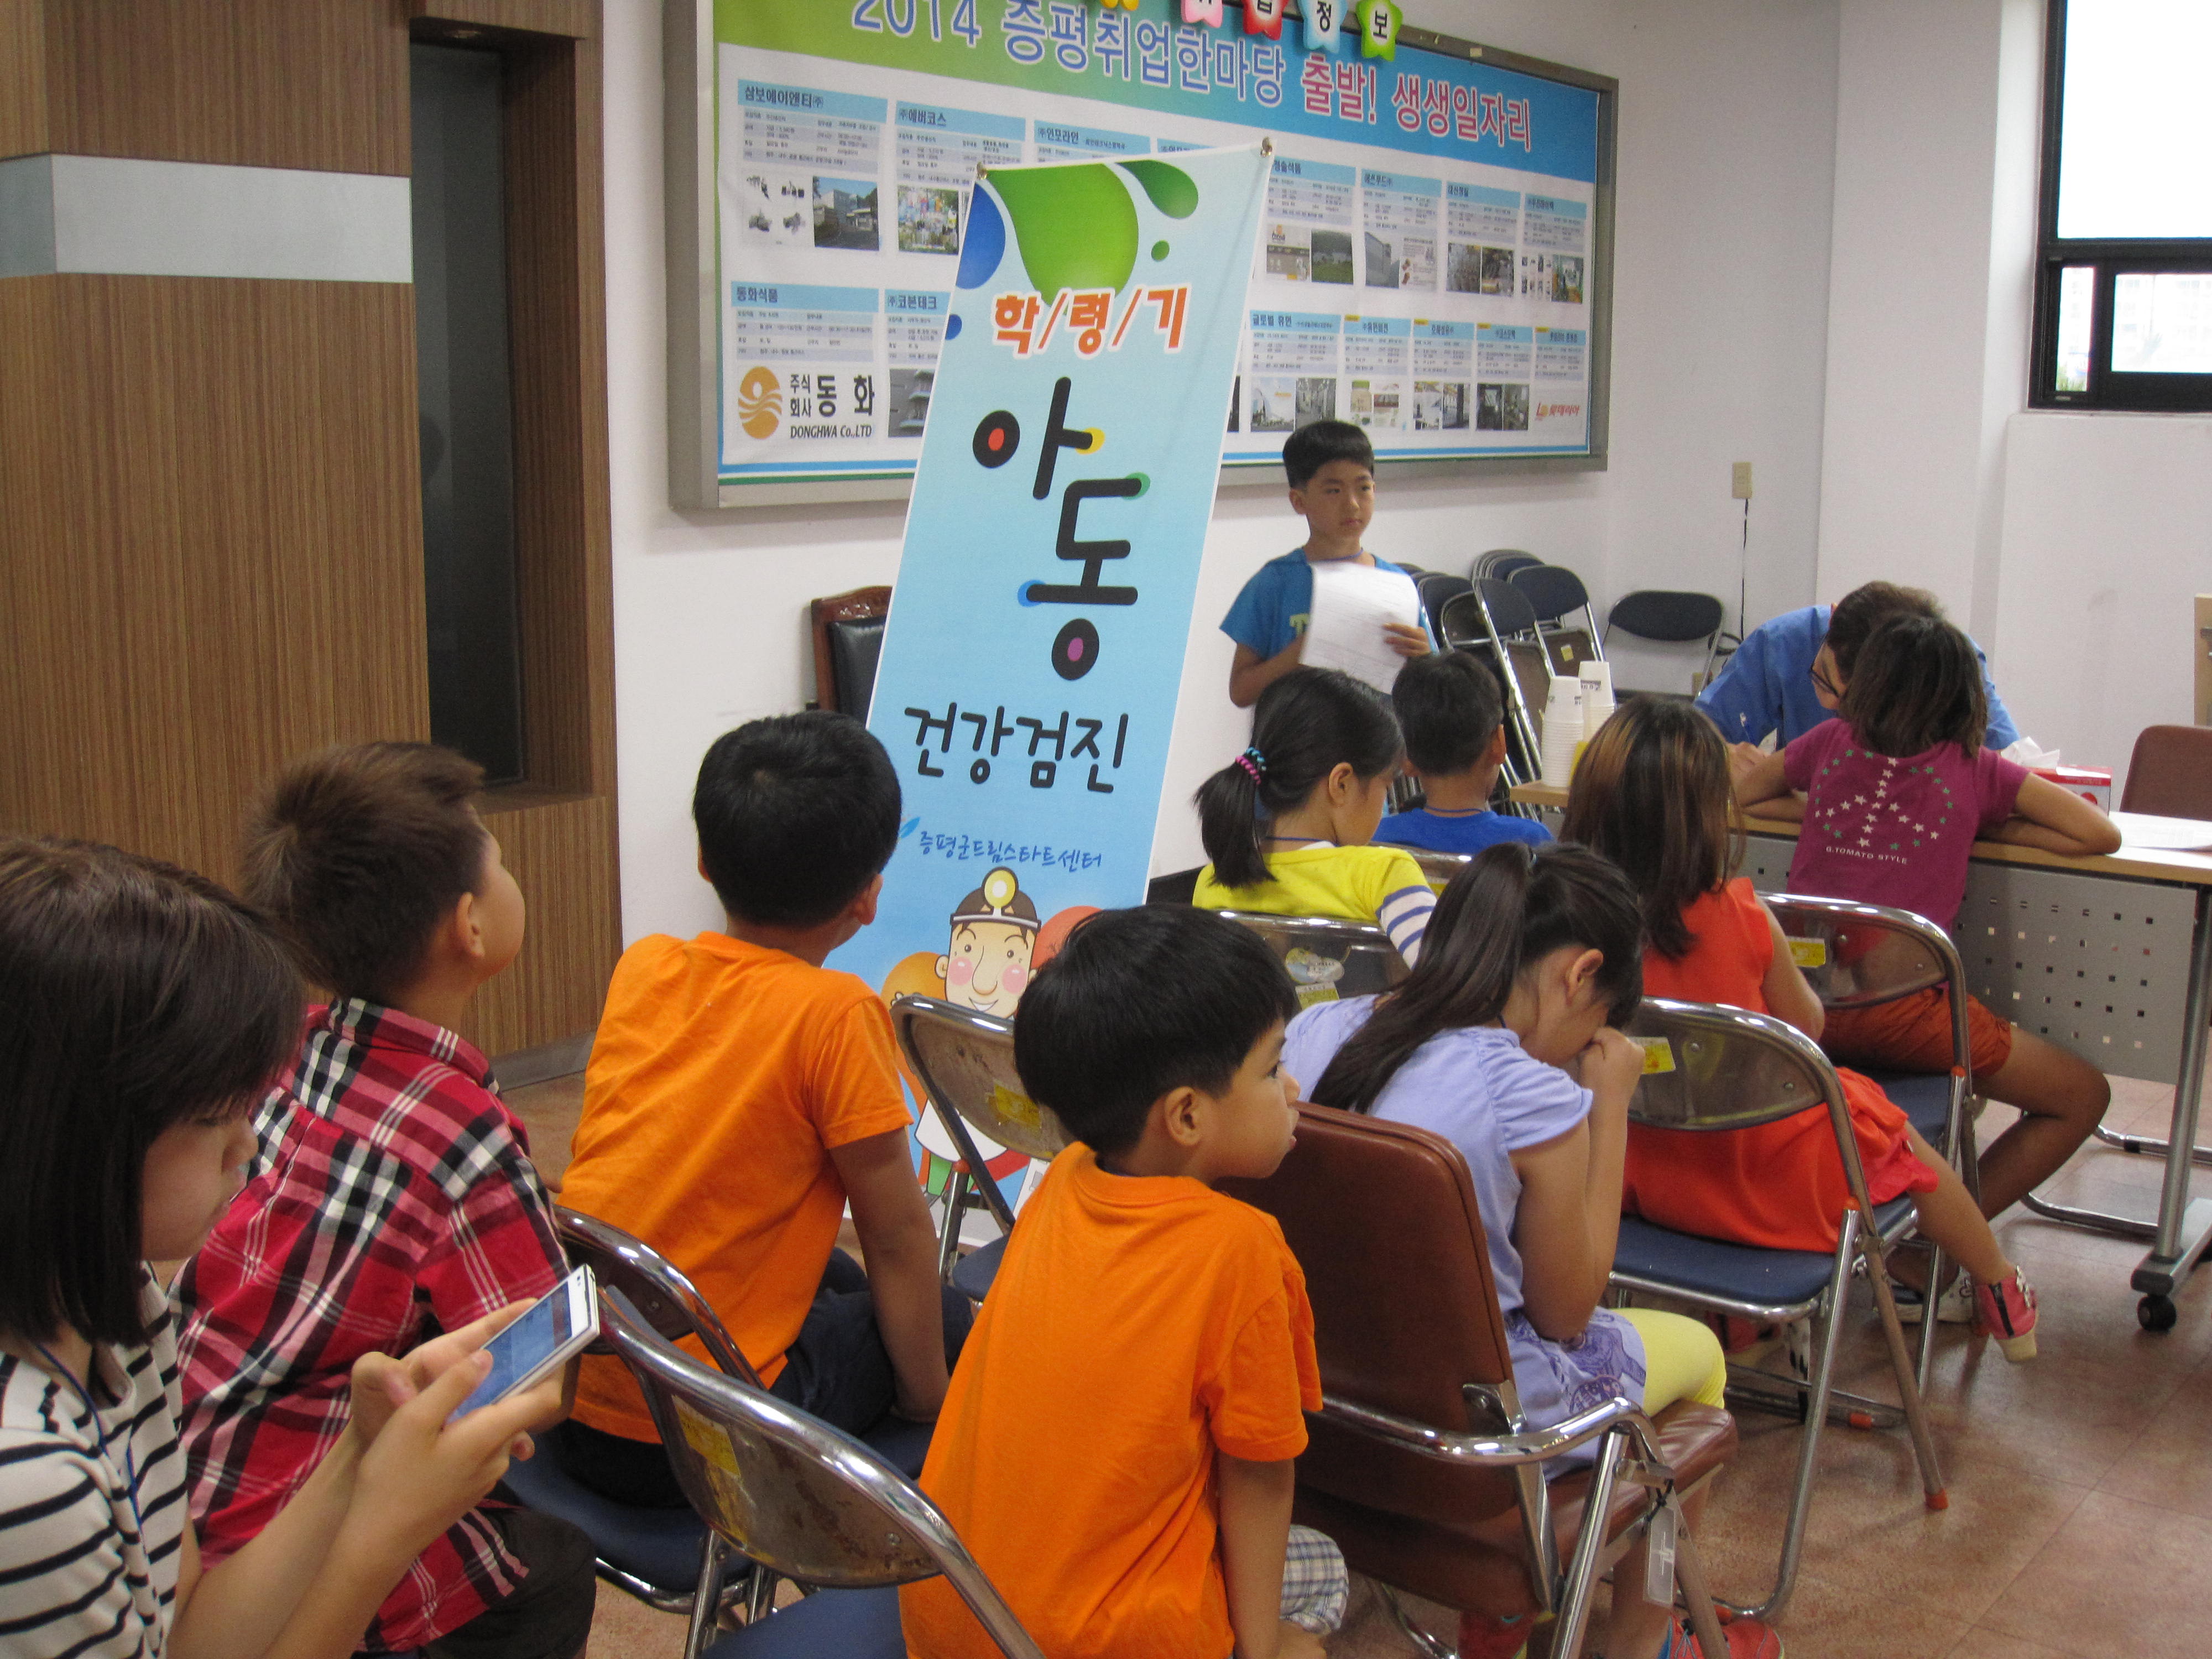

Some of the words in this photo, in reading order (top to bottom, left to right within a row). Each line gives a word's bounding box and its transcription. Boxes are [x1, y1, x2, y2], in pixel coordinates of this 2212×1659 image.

[1302, 53, 1376, 124] 출발!
[1392, 73, 1531, 152] 생생일자리
[790, 374, 811, 394] 주식
[790, 398, 811, 418] 회사
[790, 424, 837, 439] DONGHWA
[973, 377, 1142, 681] 아동
[904, 702, 1129, 794] 건강검진
